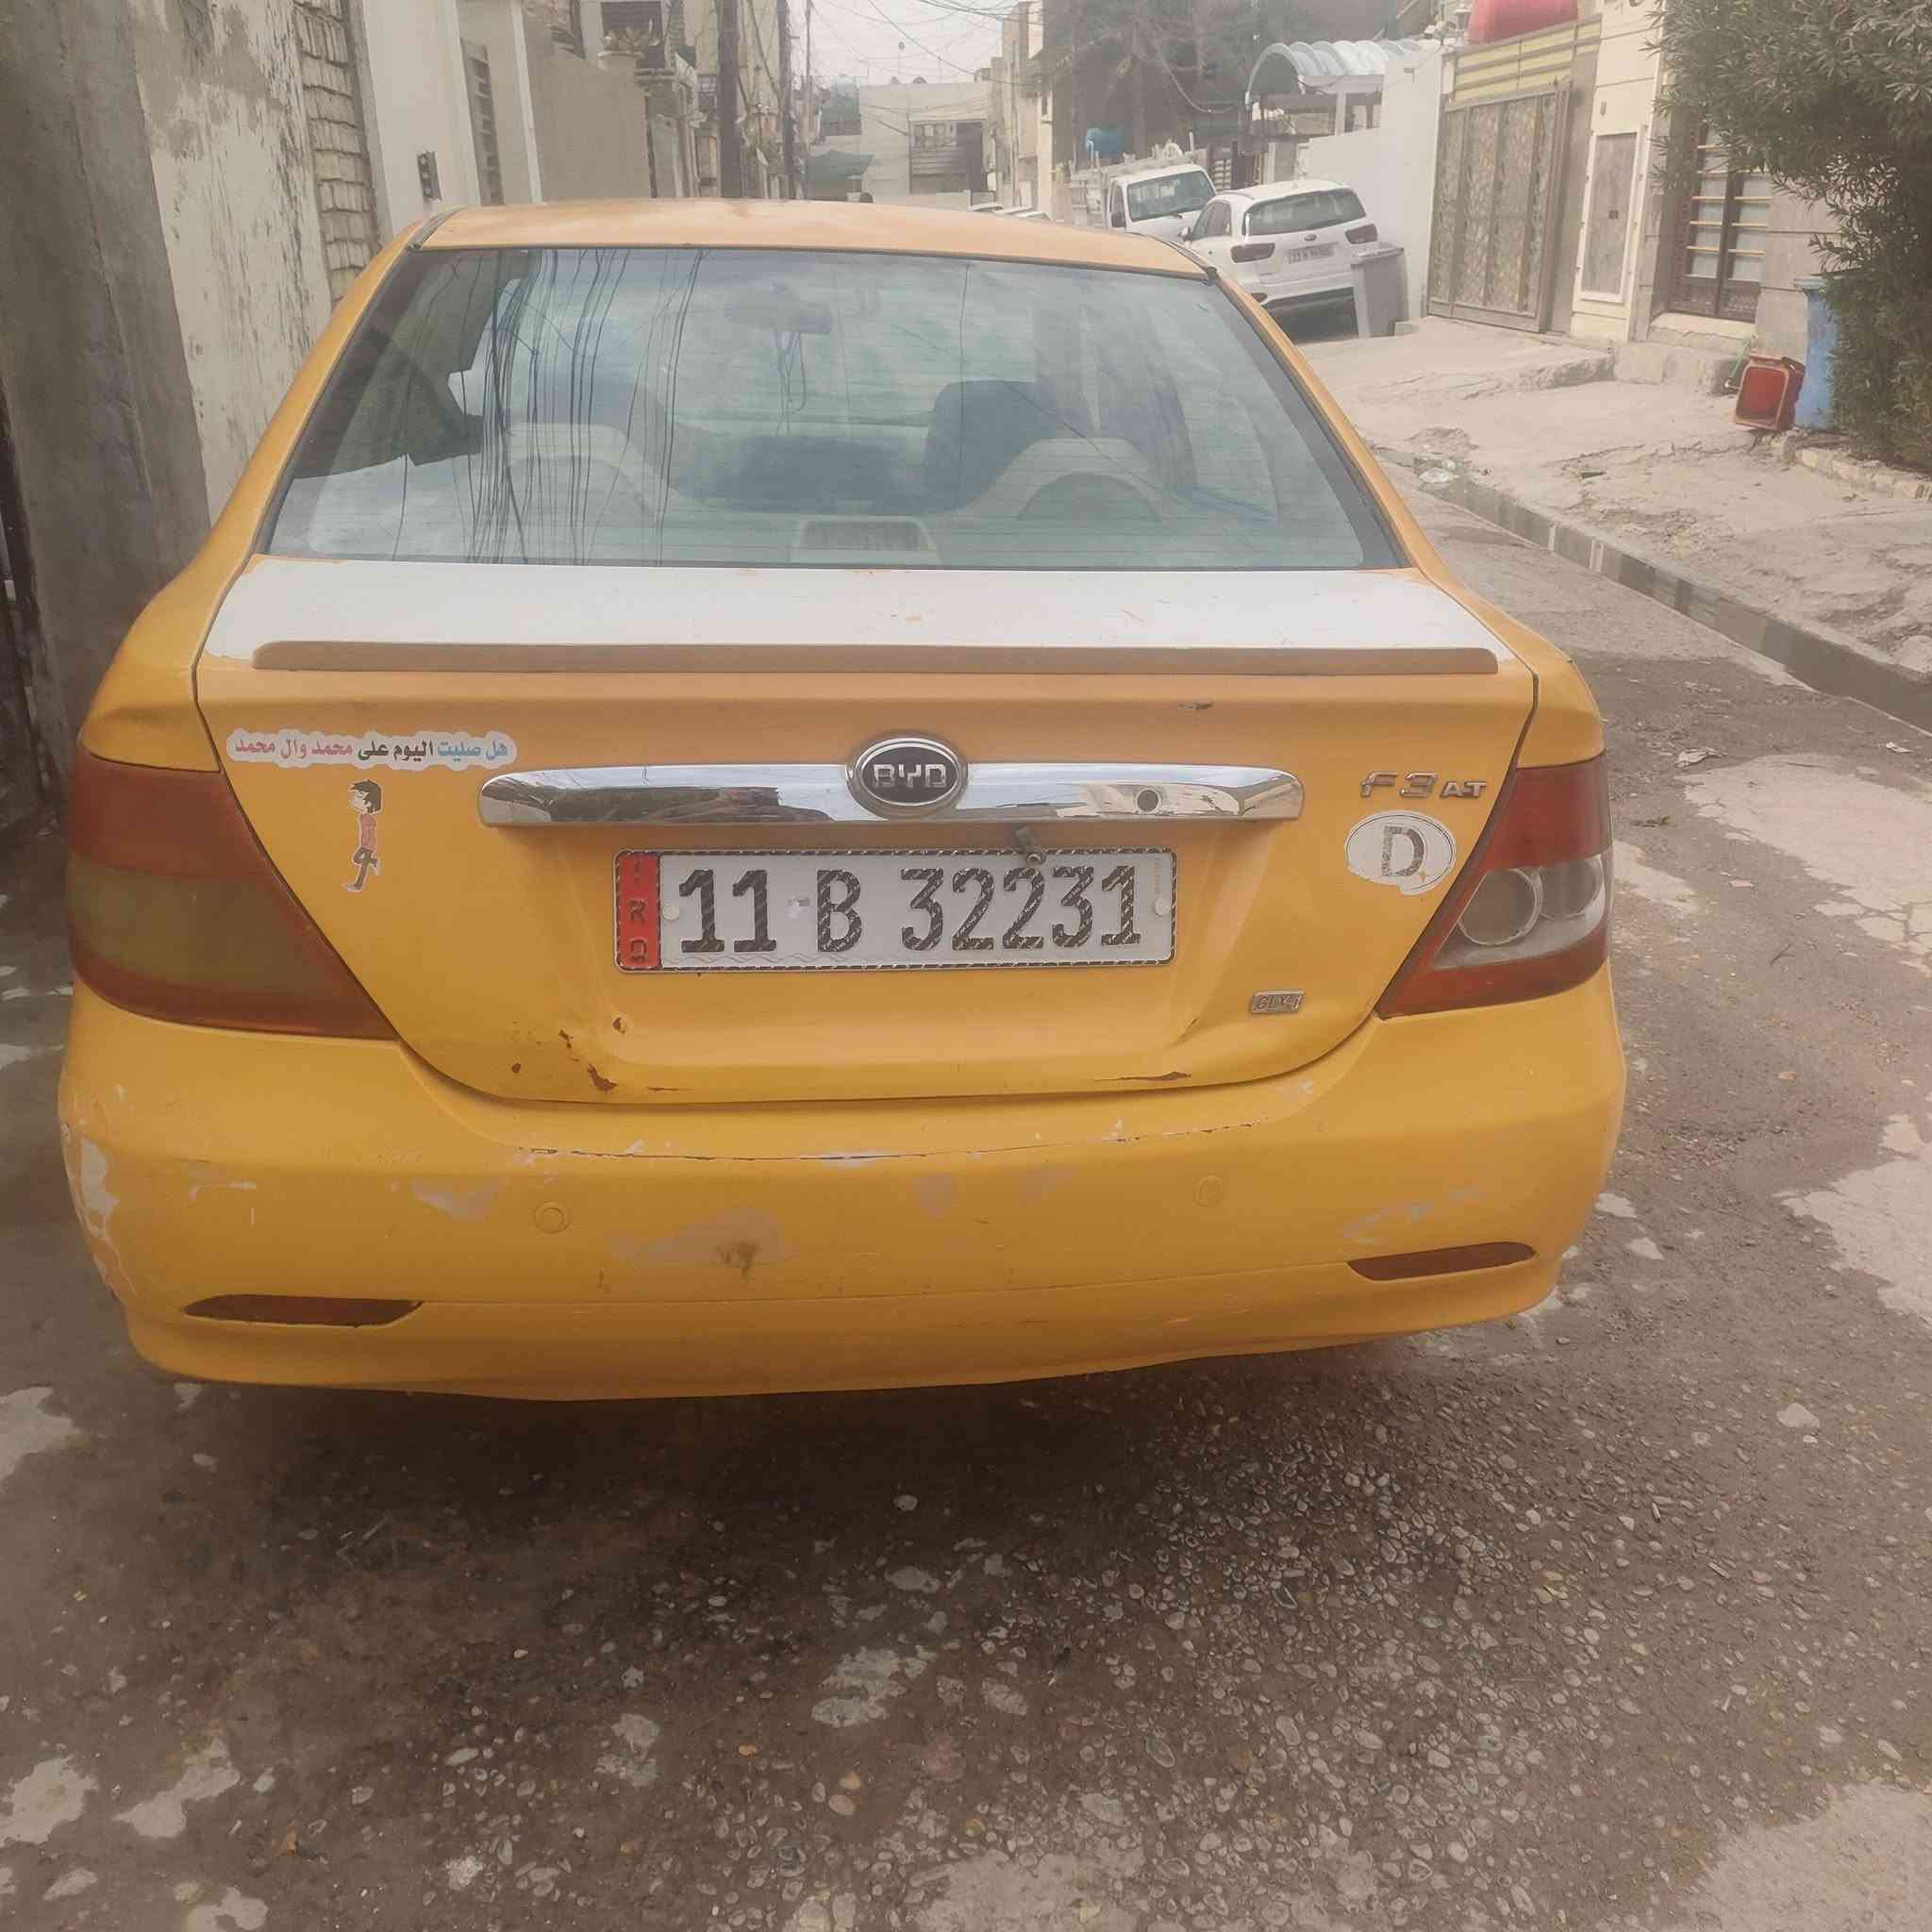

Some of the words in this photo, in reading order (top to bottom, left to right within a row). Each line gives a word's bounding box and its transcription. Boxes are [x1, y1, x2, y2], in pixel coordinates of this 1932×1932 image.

[235, 739, 275, 754] محمد
[311, 740, 353, 756] محمد
[358, 740, 390, 761] على
[392, 740, 434, 762] اليوم
[437, 740, 482, 762] صليت
[485, 741, 508, 762] هل
[873, 762, 948, 789] BYD
[1380, 825, 1426, 877] D
[677, 869, 777, 954] 11
[816, 869, 863, 953] B
[898, 864, 1142, 953] 32231
